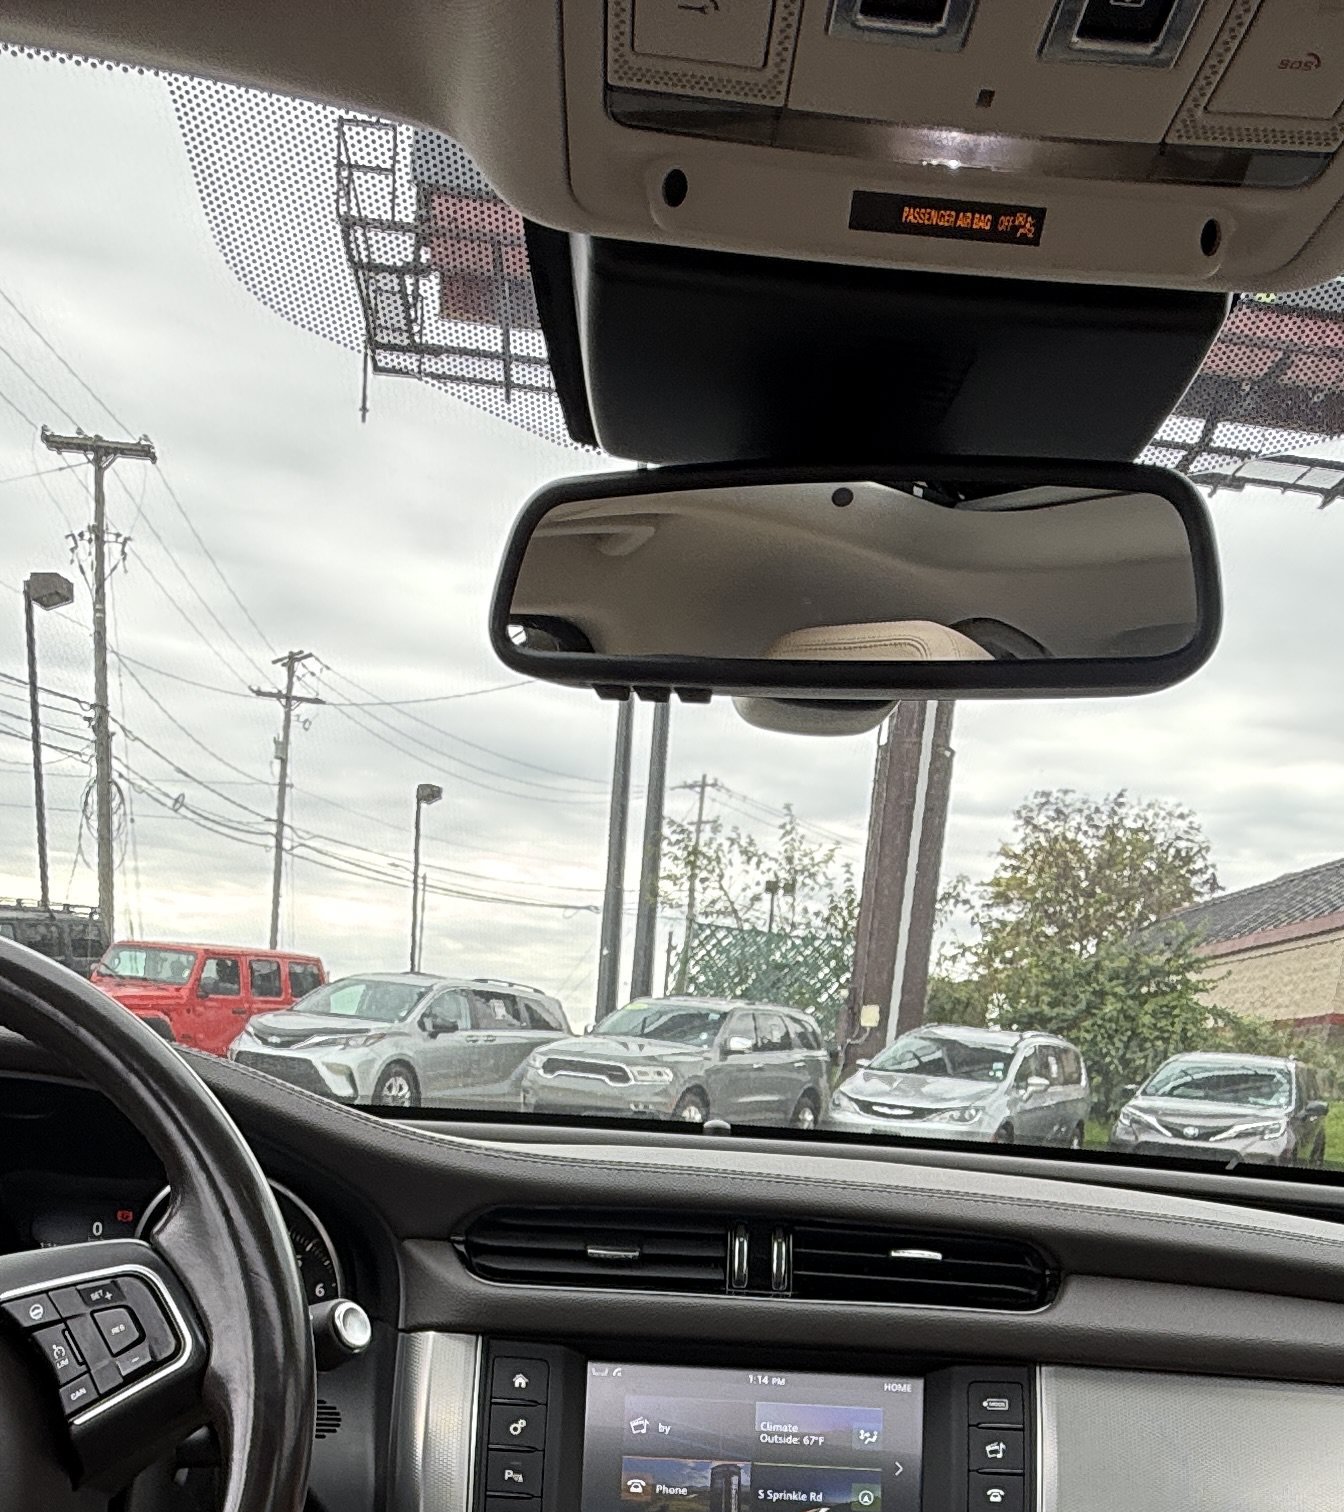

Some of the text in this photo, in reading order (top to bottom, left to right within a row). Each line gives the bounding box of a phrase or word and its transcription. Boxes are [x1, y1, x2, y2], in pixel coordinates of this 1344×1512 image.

[902, 206, 956, 228] PASSENGER
[957, 212, 971, 228] AIR
[972, 213, 993, 231] BAG
[92, 1221, 103, 1236] 0
[315, 1282, 326, 1298] 6
[748, 1374, 786, 1386] 1:14 PM
[70, 1387, 87, 1401] CAN
[883, 1383, 913, 1394] HOME
[658, 1422, 671, 1435] by
[760, 1421, 799, 1433] Climate
[759, 1434, 801, 1445] Outside:
[656, 1484, 688, 1496] Phone
[757, 1489, 824, 1503] S Sprinkle Rd
